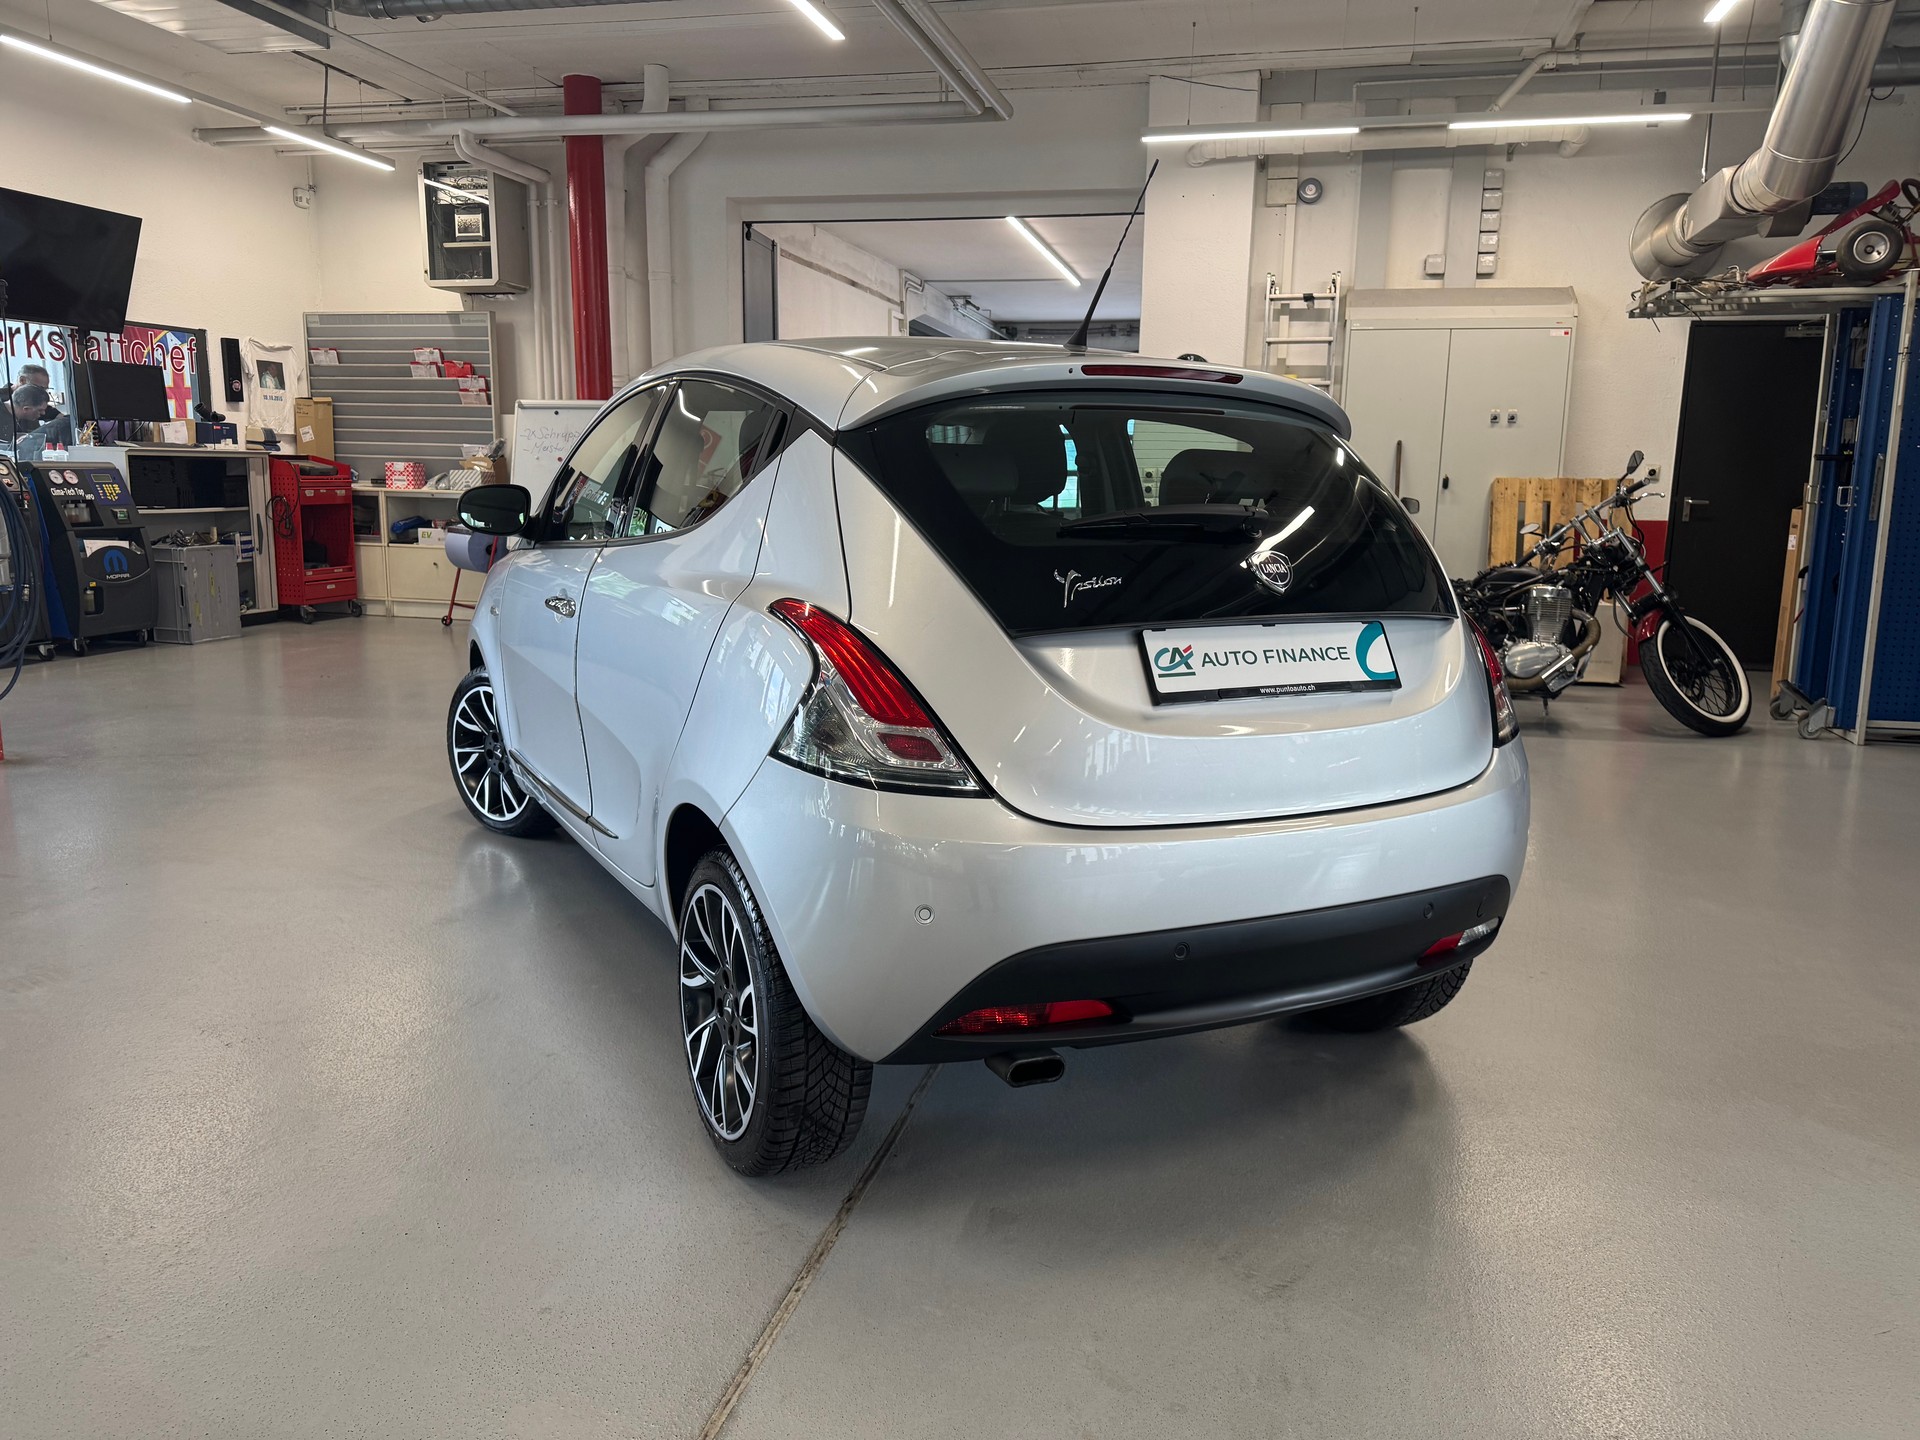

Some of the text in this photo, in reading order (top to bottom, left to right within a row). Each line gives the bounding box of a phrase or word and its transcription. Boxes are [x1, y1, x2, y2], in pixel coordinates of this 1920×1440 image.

[0, 322, 197, 375] rkstattchef
[74, 487, 85, 498] Top
[421, 531, 432, 539] EV
[1261, 563, 1288, 574] LANCIA
[1053, 569, 1122, 608] Ypsilon
[1201, 650, 1258, 668] AUTO
[1263, 646, 1351, 664] FINANCE
[1260, 684, 1316, 694] www.puntoauto.ch
